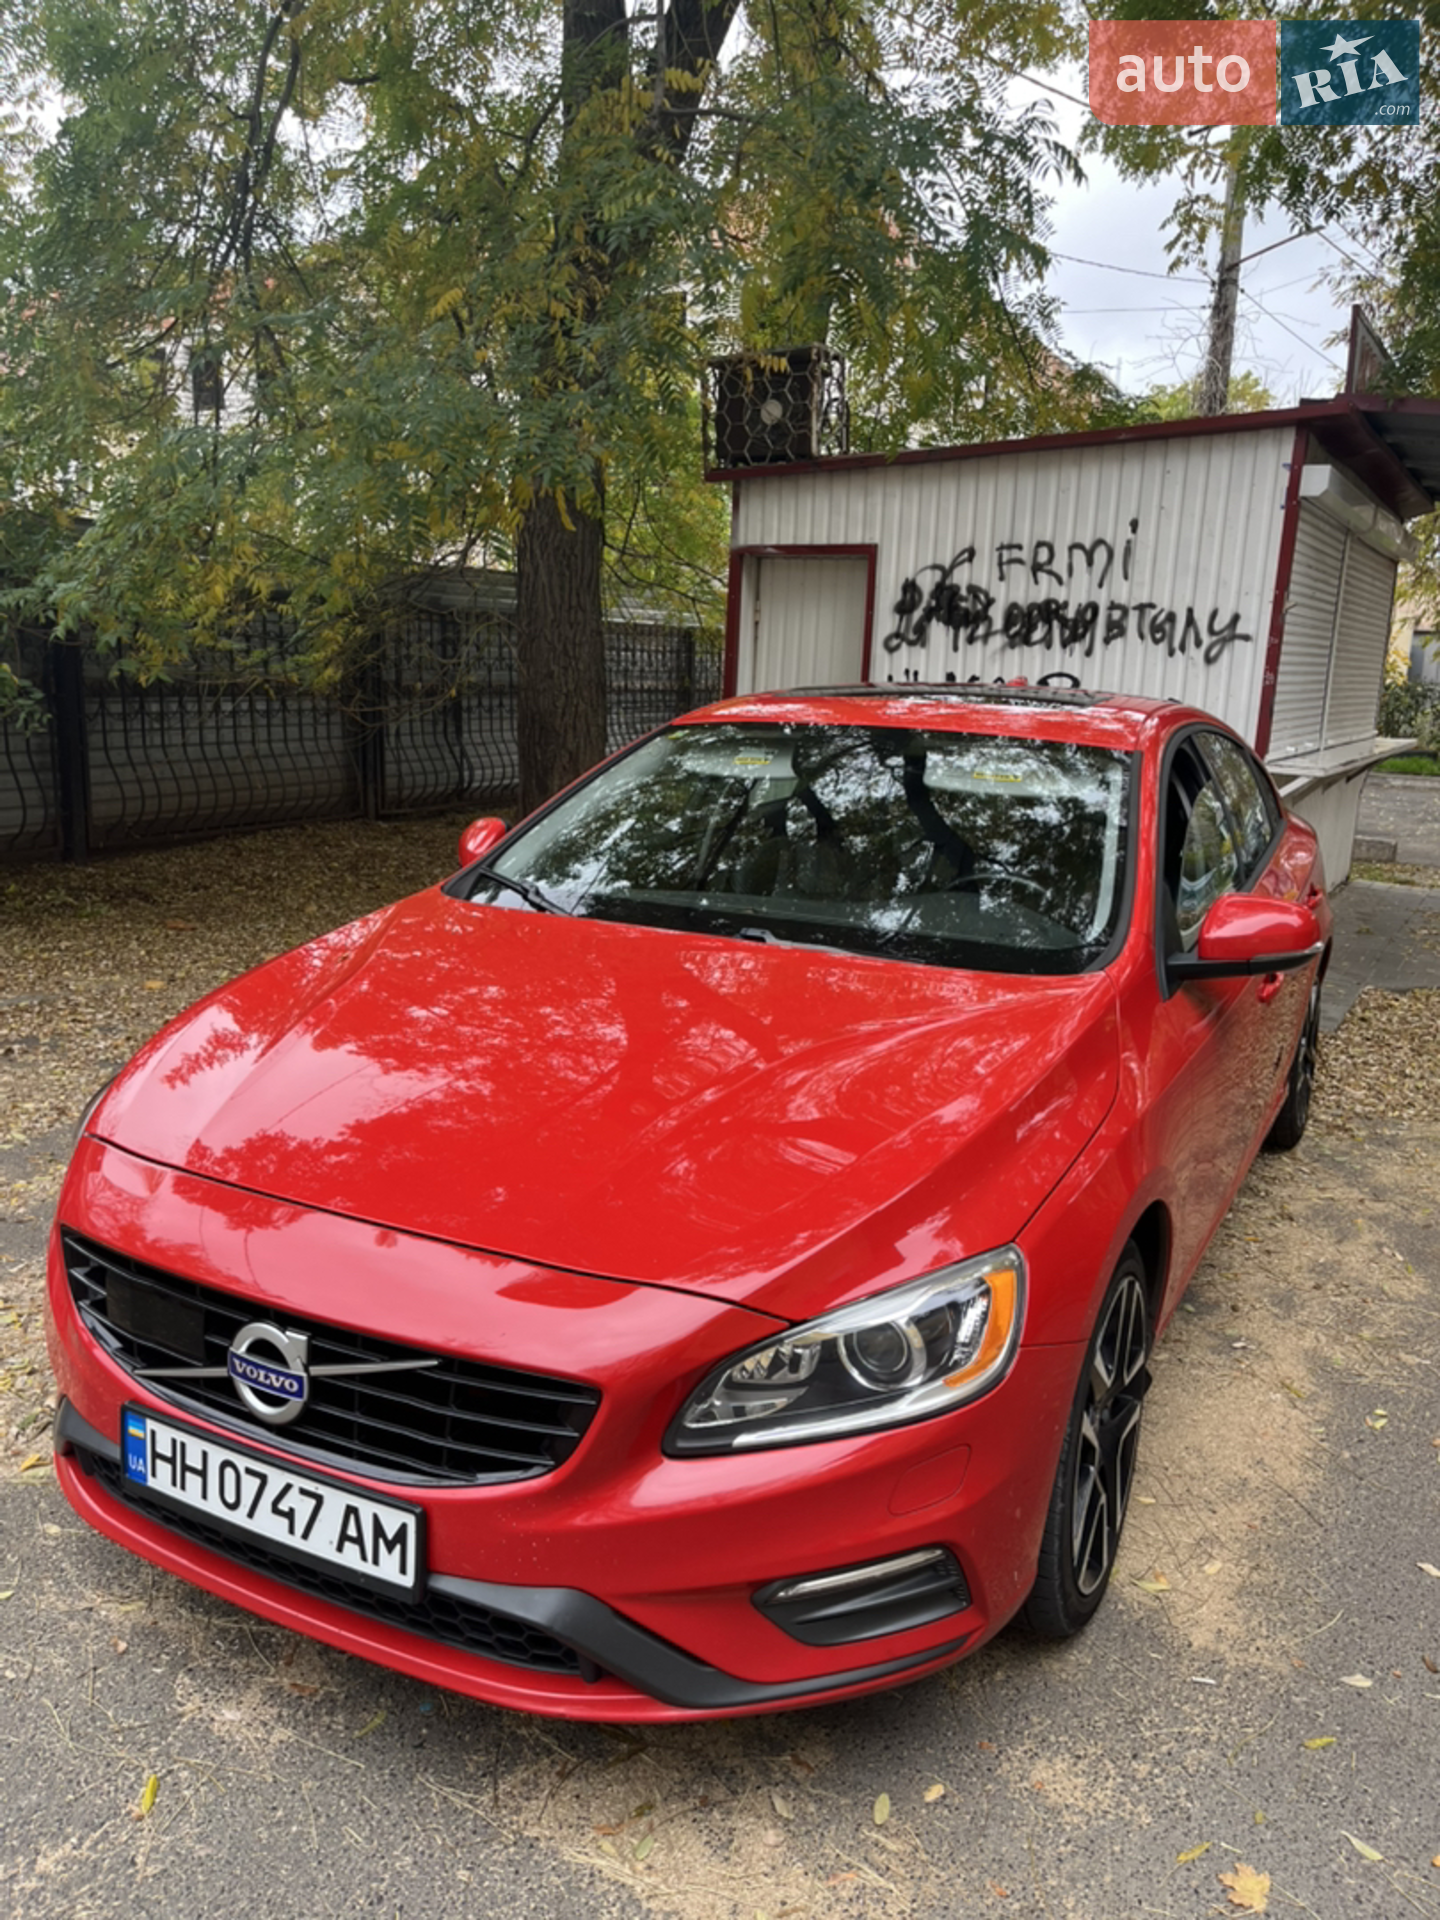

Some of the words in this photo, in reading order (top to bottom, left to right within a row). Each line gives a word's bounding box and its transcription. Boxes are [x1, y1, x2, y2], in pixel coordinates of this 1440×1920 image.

[232, 1356, 299, 1393] VOLVO
[128, 1453, 146, 1474] UA
[335, 1503, 408, 1577] AM
